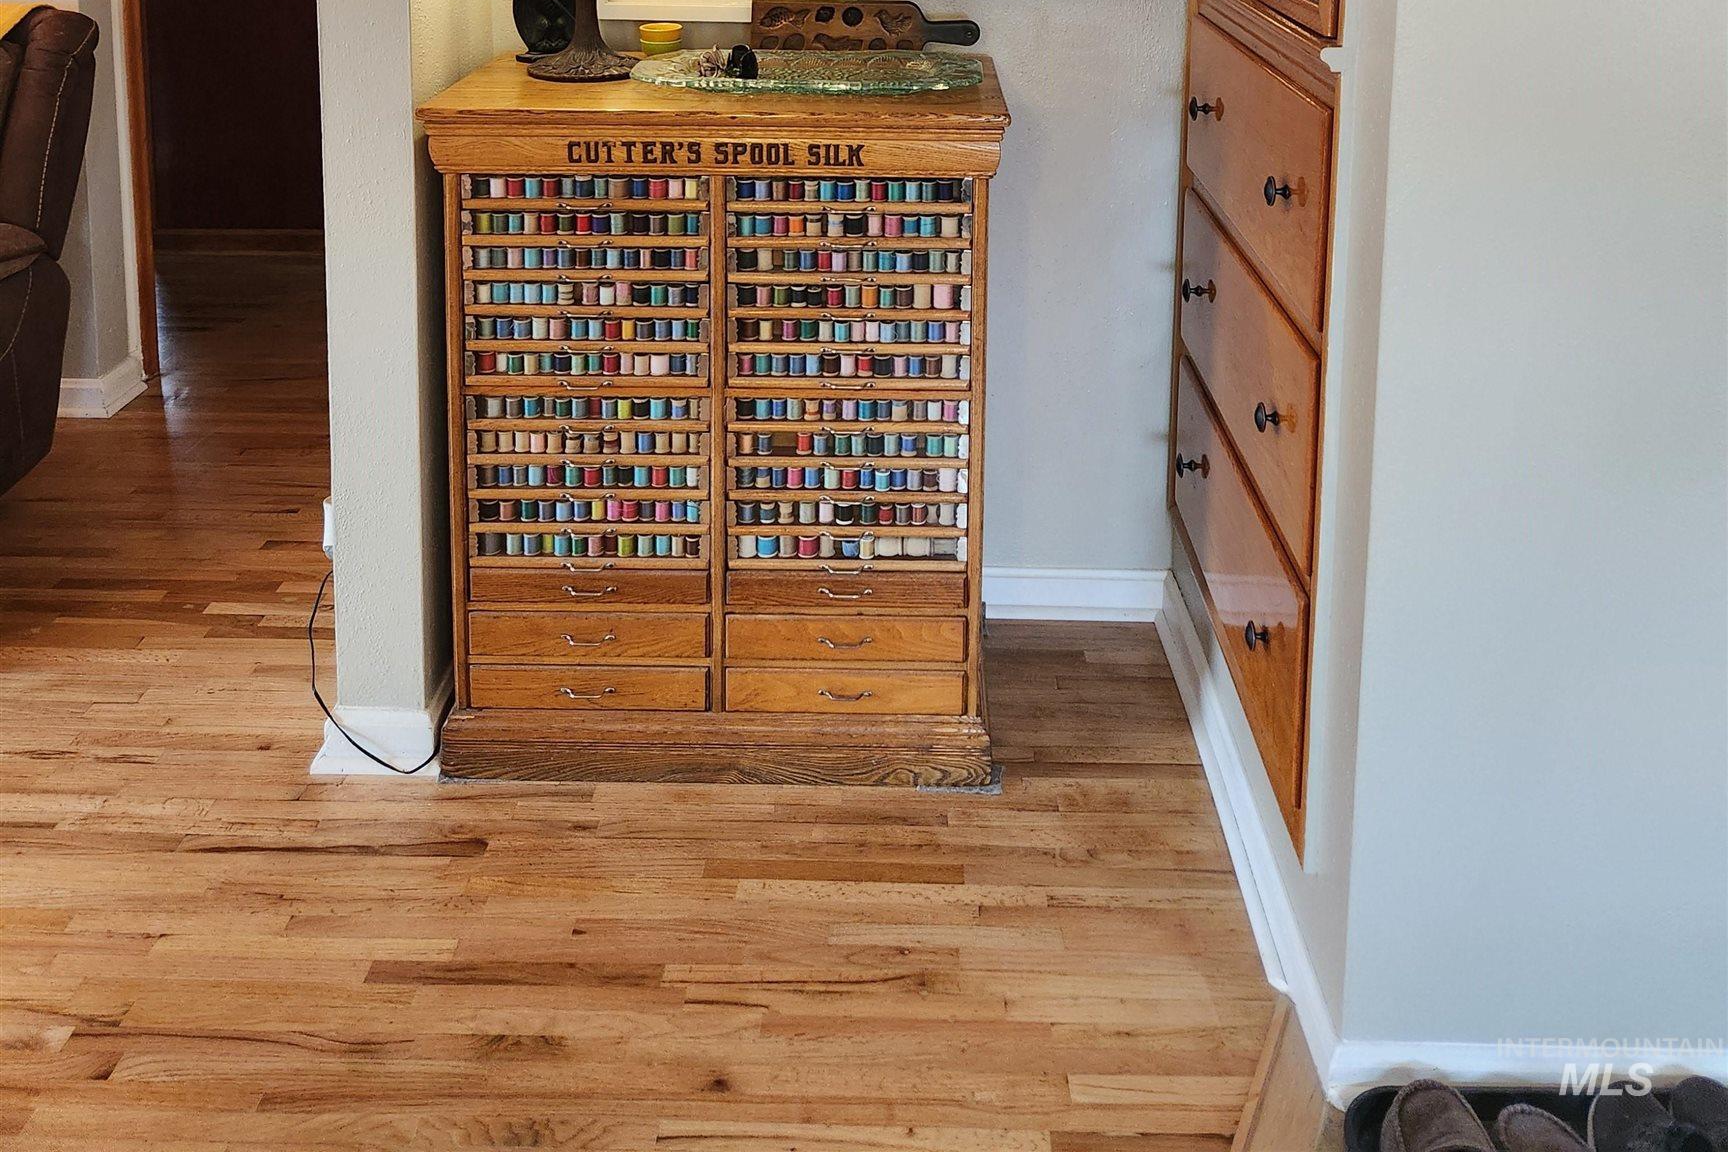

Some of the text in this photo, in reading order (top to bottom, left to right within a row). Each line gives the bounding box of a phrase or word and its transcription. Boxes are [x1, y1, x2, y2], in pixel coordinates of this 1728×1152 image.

[567, 141, 866, 167] CUTTER'S SPOOL SILK
